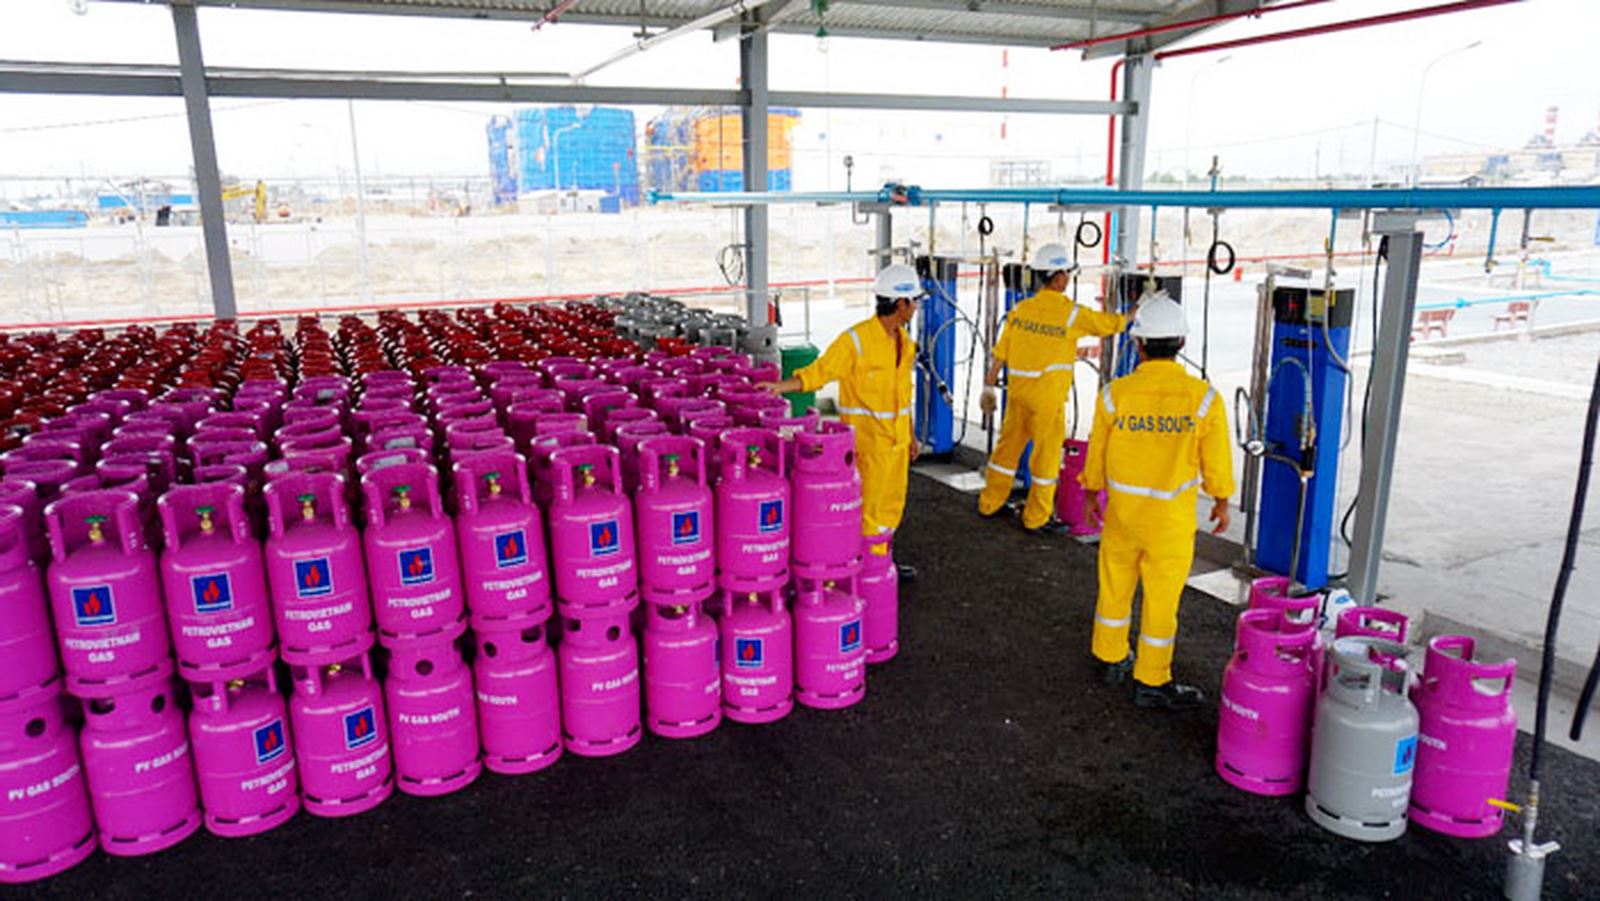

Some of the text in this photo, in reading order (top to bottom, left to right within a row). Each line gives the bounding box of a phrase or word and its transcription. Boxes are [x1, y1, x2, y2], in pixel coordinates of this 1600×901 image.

[1128, 415, 1154, 432] GAS
[506, 588, 528, 601] GAS
[410, 606, 434, 619] GAS
[307, 620, 332, 632] GAS
[206, 635, 232, 648] GAS
[87, 651, 115, 663] GAS
[489, 695, 518, 705] SOUTH
[411, 714, 430, 724] GAS
[431, 705, 460, 724] SOUTH
[134, 761, 150, 773] PV
[152, 752, 172, 769] GAS
[356, 764, 377, 780] GAS
[8, 789, 24, 800] PV
[27, 781, 50, 797] GAS
[267, 778, 288, 794] GAS
